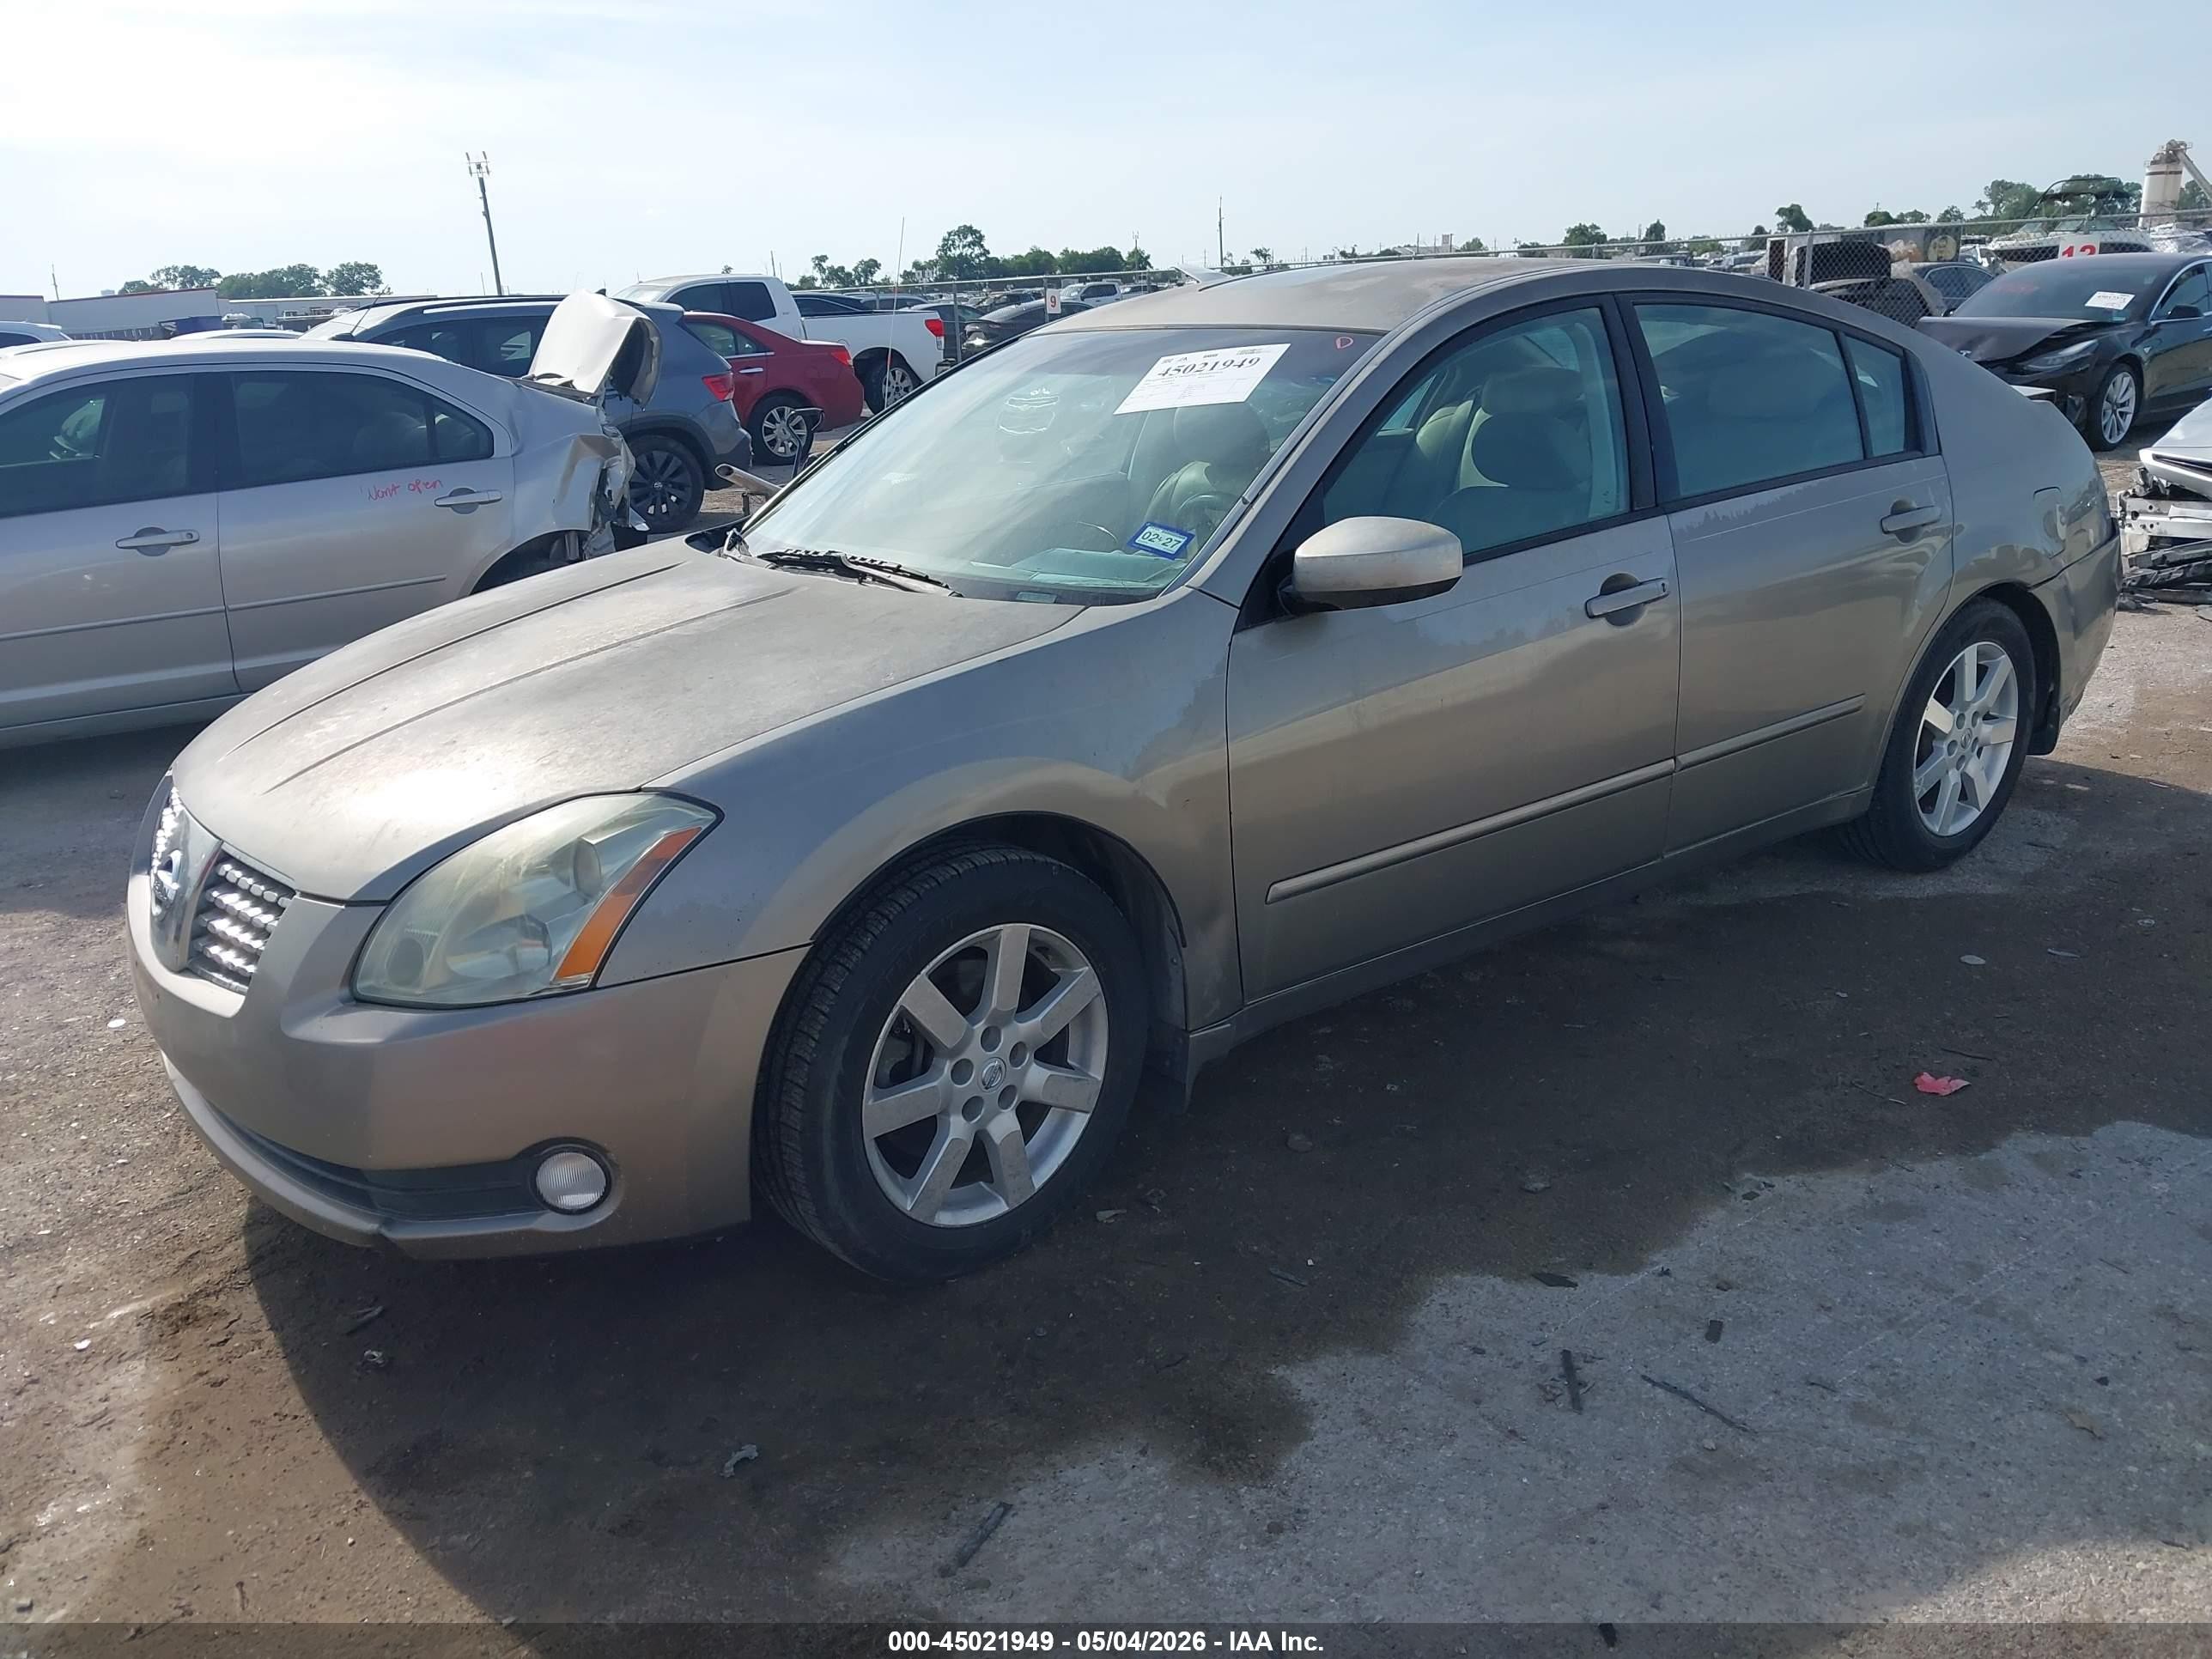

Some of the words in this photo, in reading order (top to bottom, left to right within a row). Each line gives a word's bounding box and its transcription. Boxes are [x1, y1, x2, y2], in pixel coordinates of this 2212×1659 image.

[1050, 295, 1057, 308] 9
[1158, 356, 1261, 378] 45021949
[1141, 531, 1160, 543] 02
[1161, 537, 1182, 549] 27
